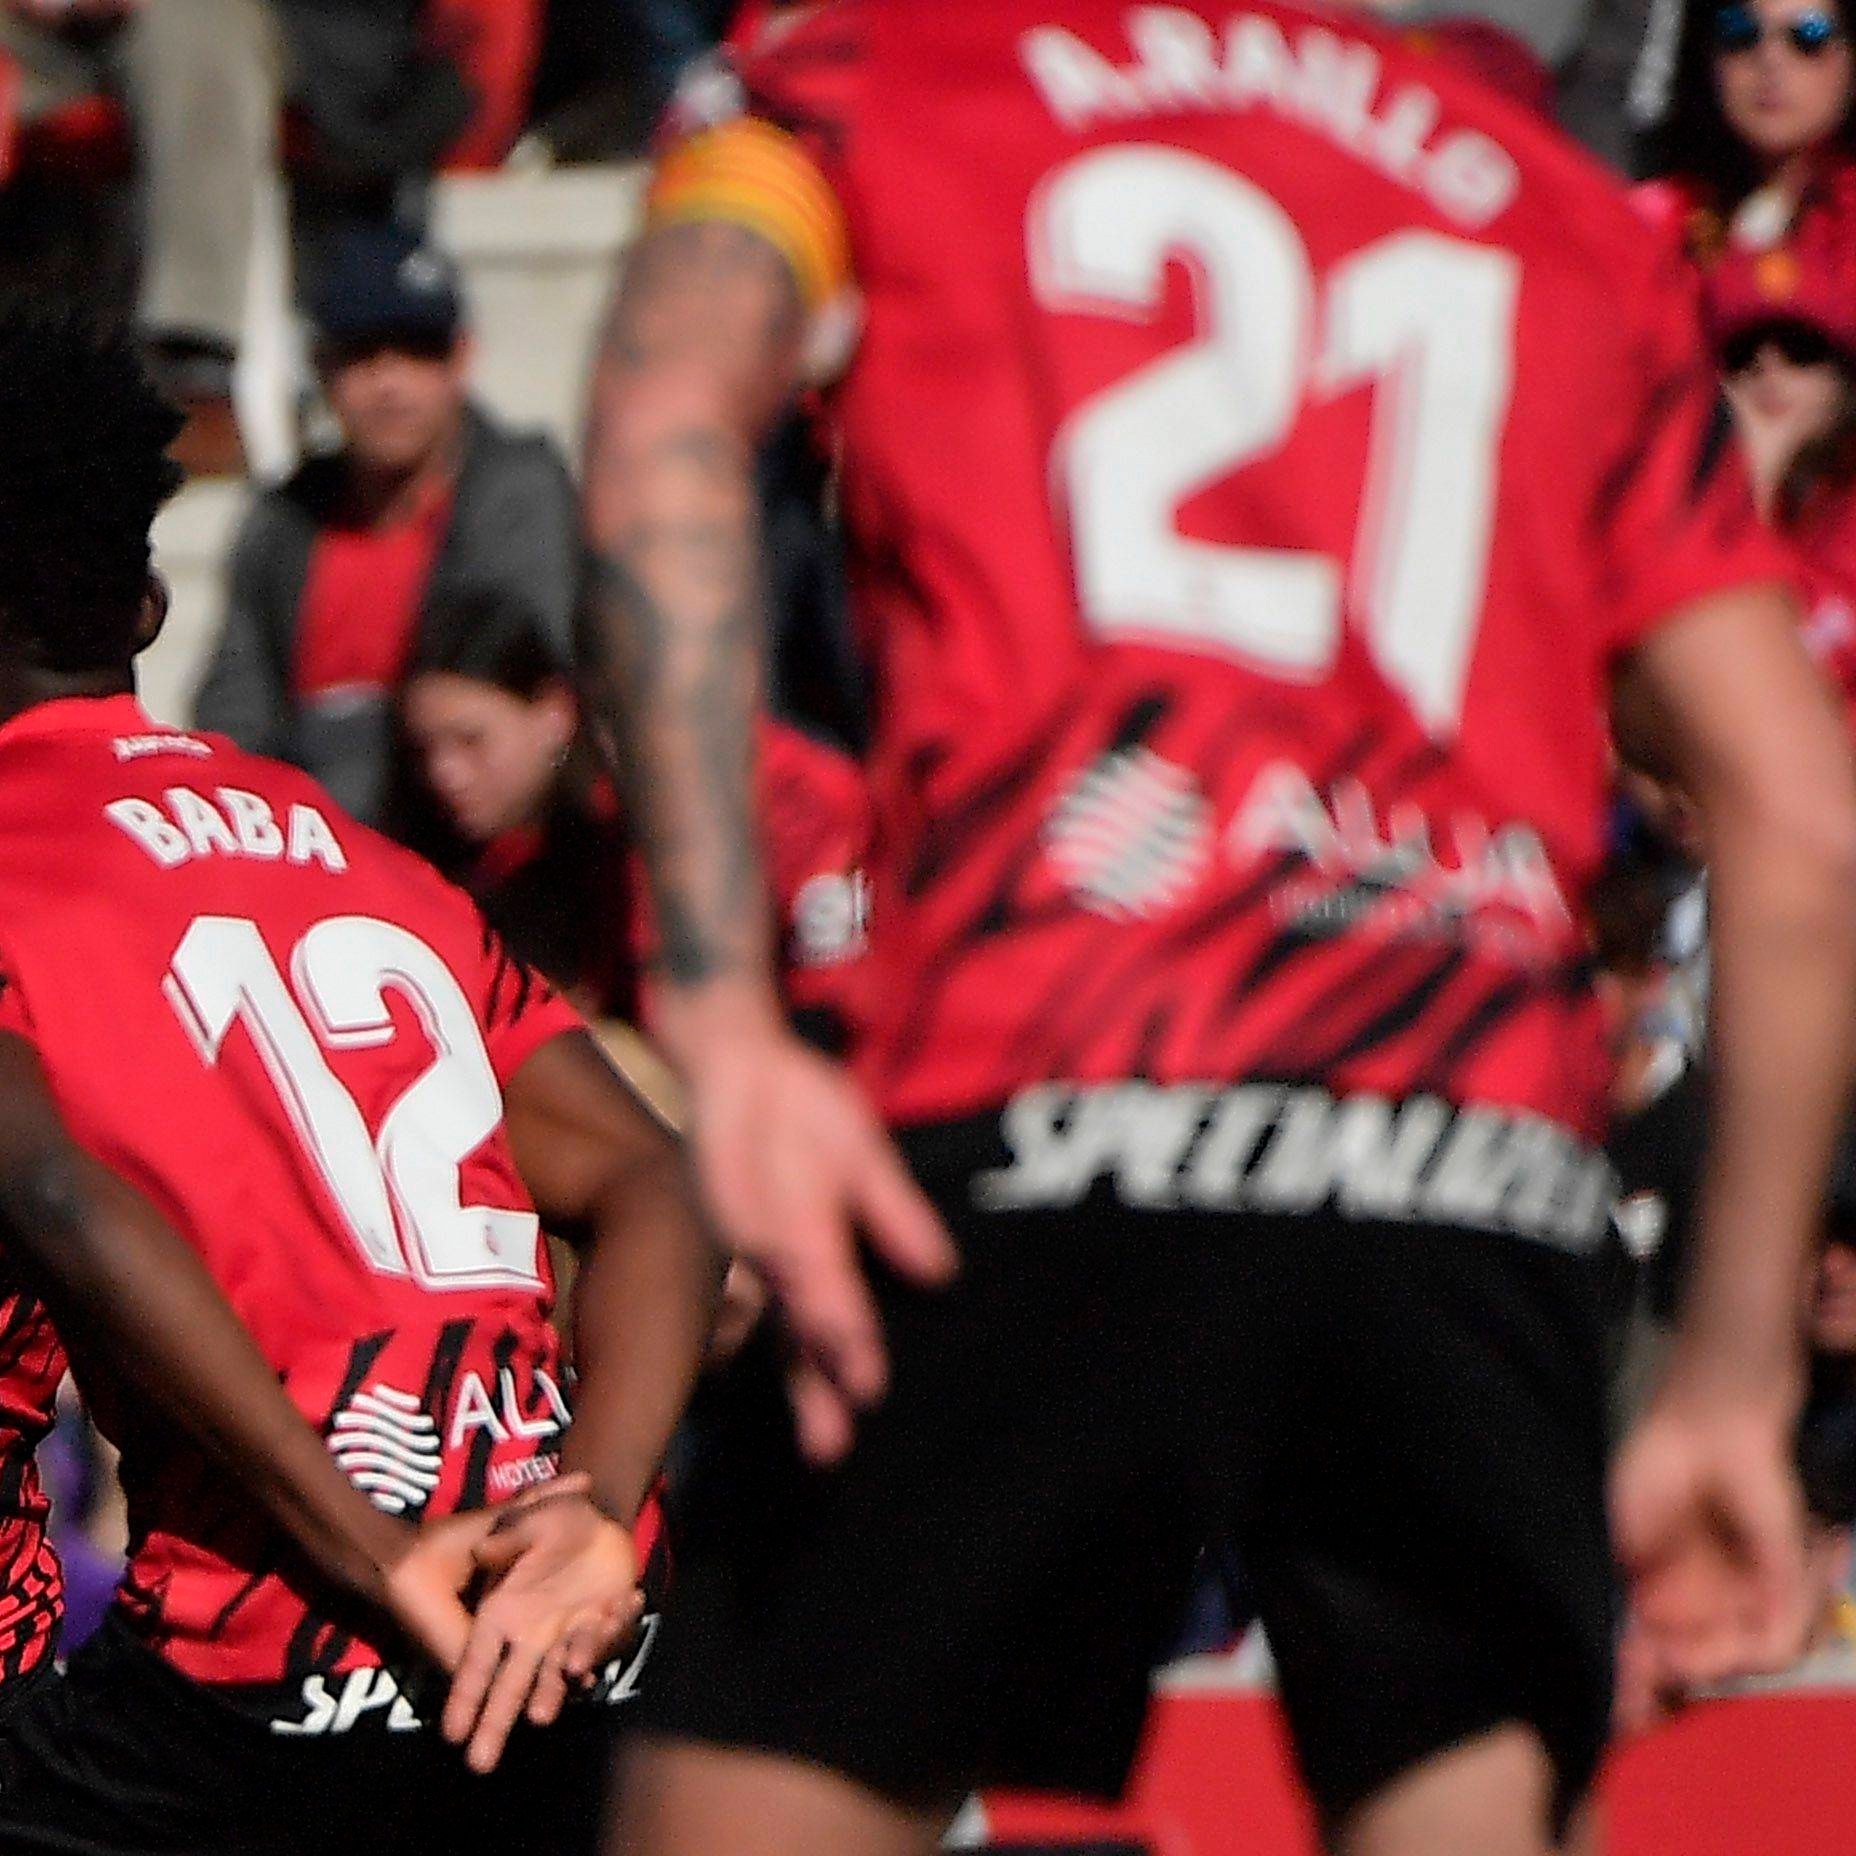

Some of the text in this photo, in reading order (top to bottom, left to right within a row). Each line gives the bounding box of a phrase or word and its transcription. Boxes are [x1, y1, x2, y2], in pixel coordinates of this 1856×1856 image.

[1026, 143, 1521, 742] 21
[104, 785, 348, 873] BABA
[161, 915, 548, 1293] 12
